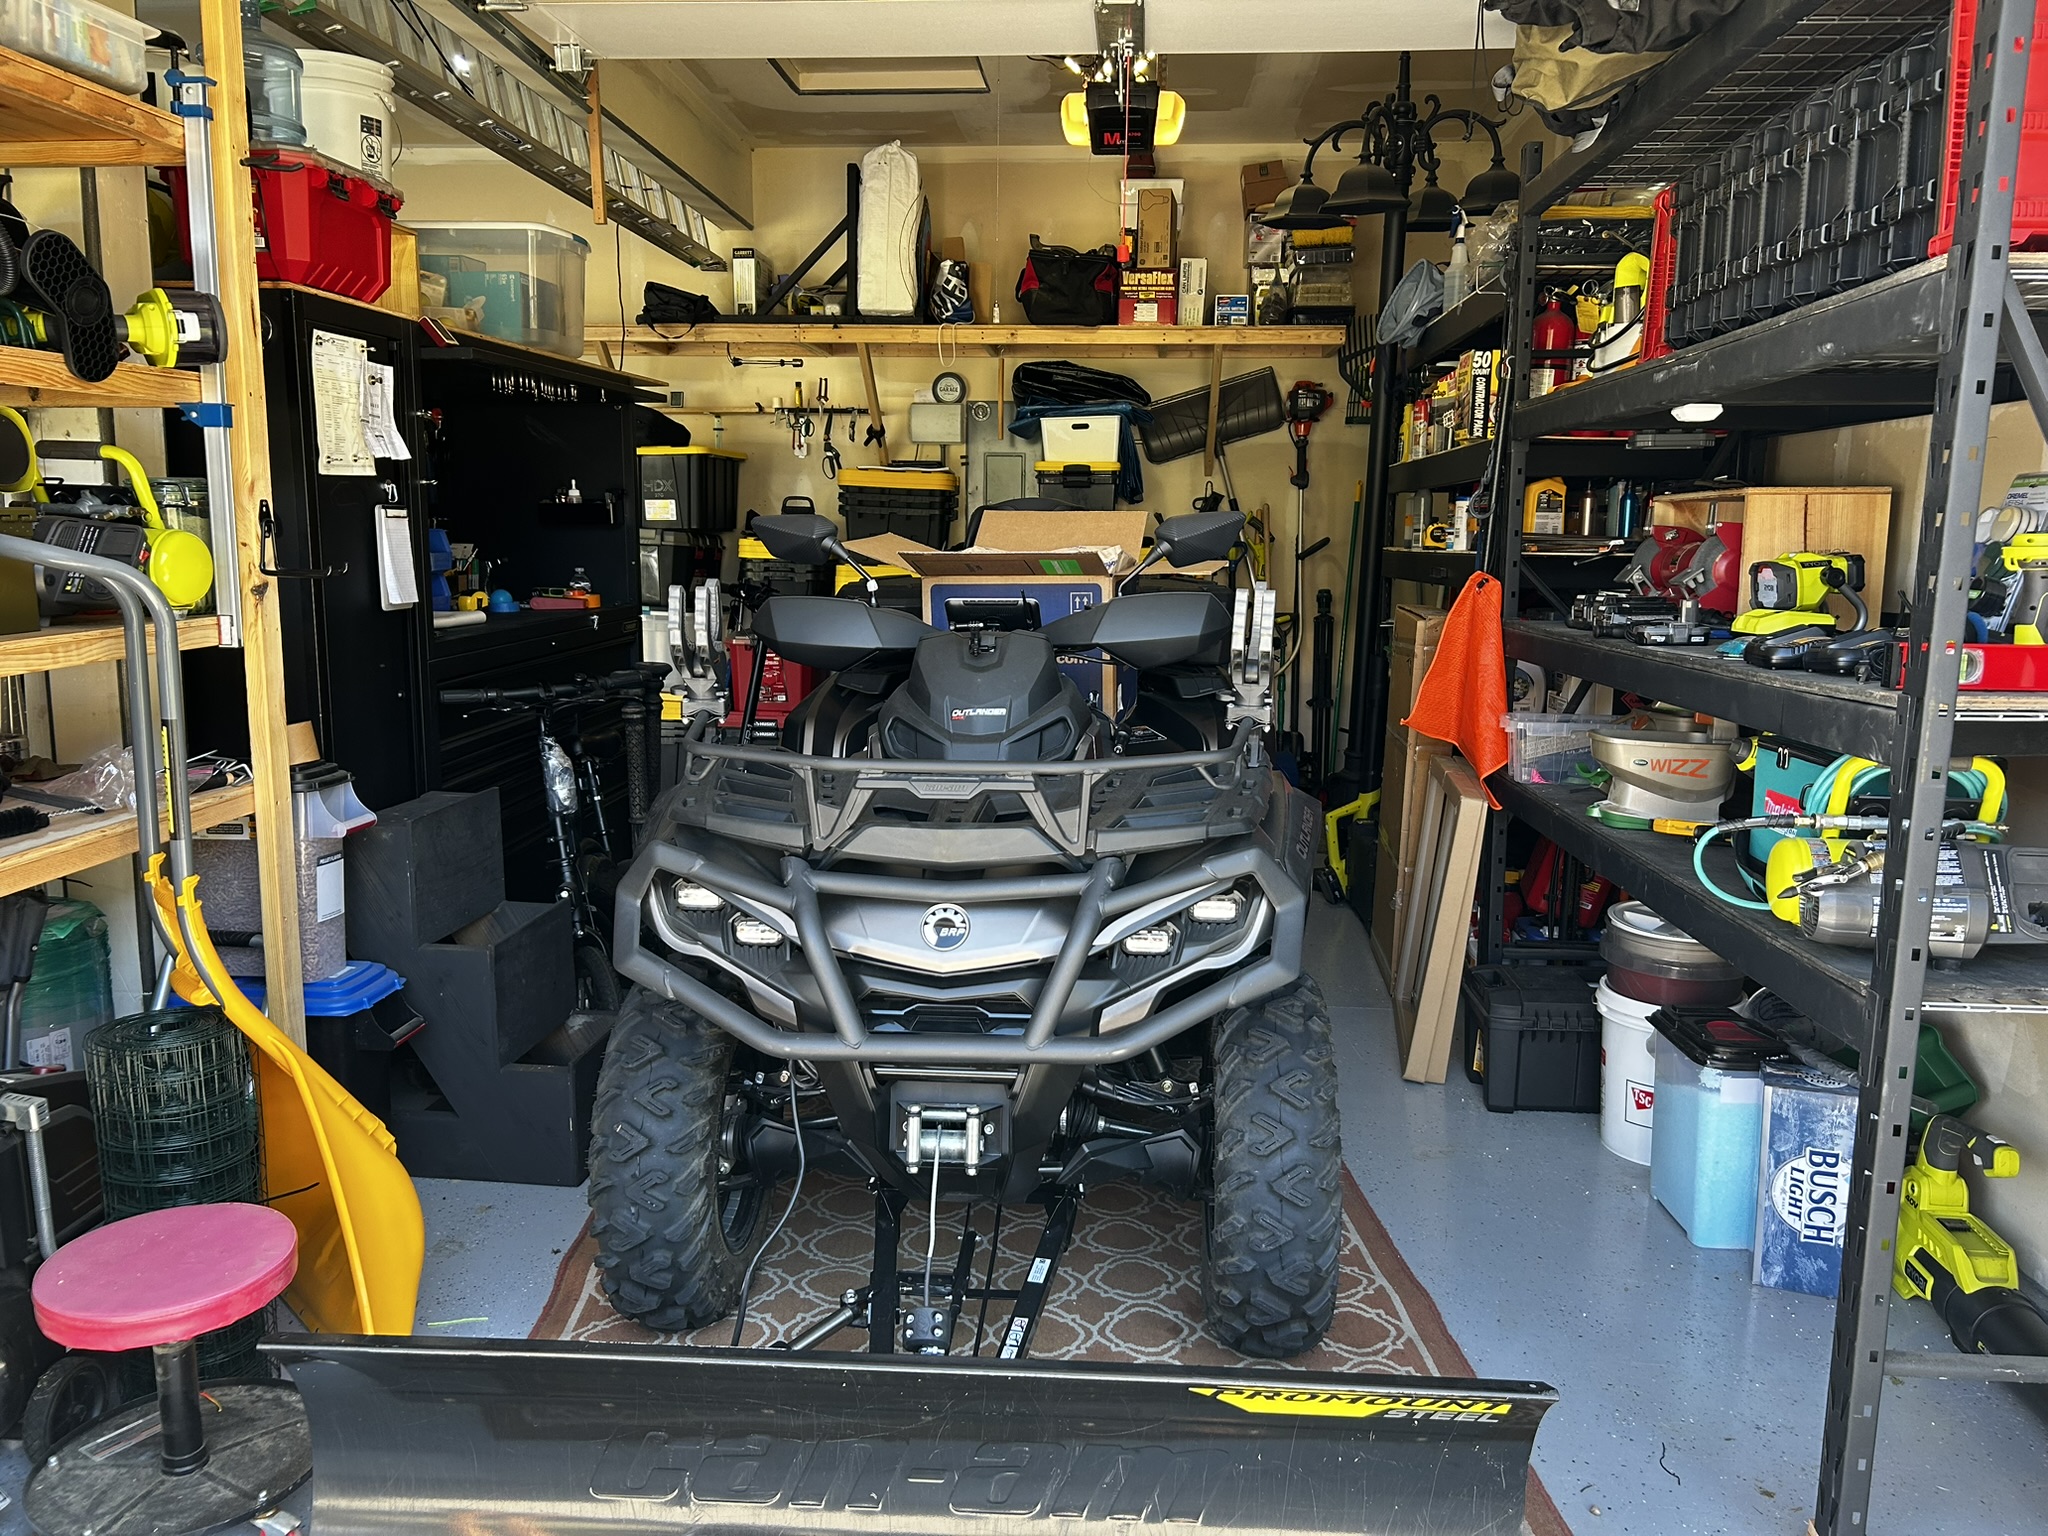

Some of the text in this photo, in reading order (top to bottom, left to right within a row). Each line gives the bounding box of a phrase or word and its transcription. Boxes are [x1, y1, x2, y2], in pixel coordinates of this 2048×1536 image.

[1122, 271, 1174, 285] VersaFlex
[1472, 351, 1492, 368] 50
[1472, 368, 1490, 376] COUNT
[1472, 377, 1486, 437] CONTRACTOR PACK
[643, 480, 674, 492] HDX
[2006, 492, 2028, 500] DREMEL
[951, 708, 1007, 716] OUTLANDER
[1650, 758, 1711, 779] WIZZ
[1296, 805, 1314, 860] OUTLANDER
[939, 927, 966, 937] BRP
[1633, 1088, 1652, 1109] TSC
[1787, 1165, 1805, 1222] LIGHT
[1802, 1149, 1841, 1244] BUSCH
[1905, 1194, 1919, 1209] 40V
[1905, 1264, 1927, 1292] RYOBI
[1213, 1388, 1505, 1412] PROMOUNT
[1383, 1409, 1500, 1423] STEEL
[588, 1432, 1229, 1523] can-am
